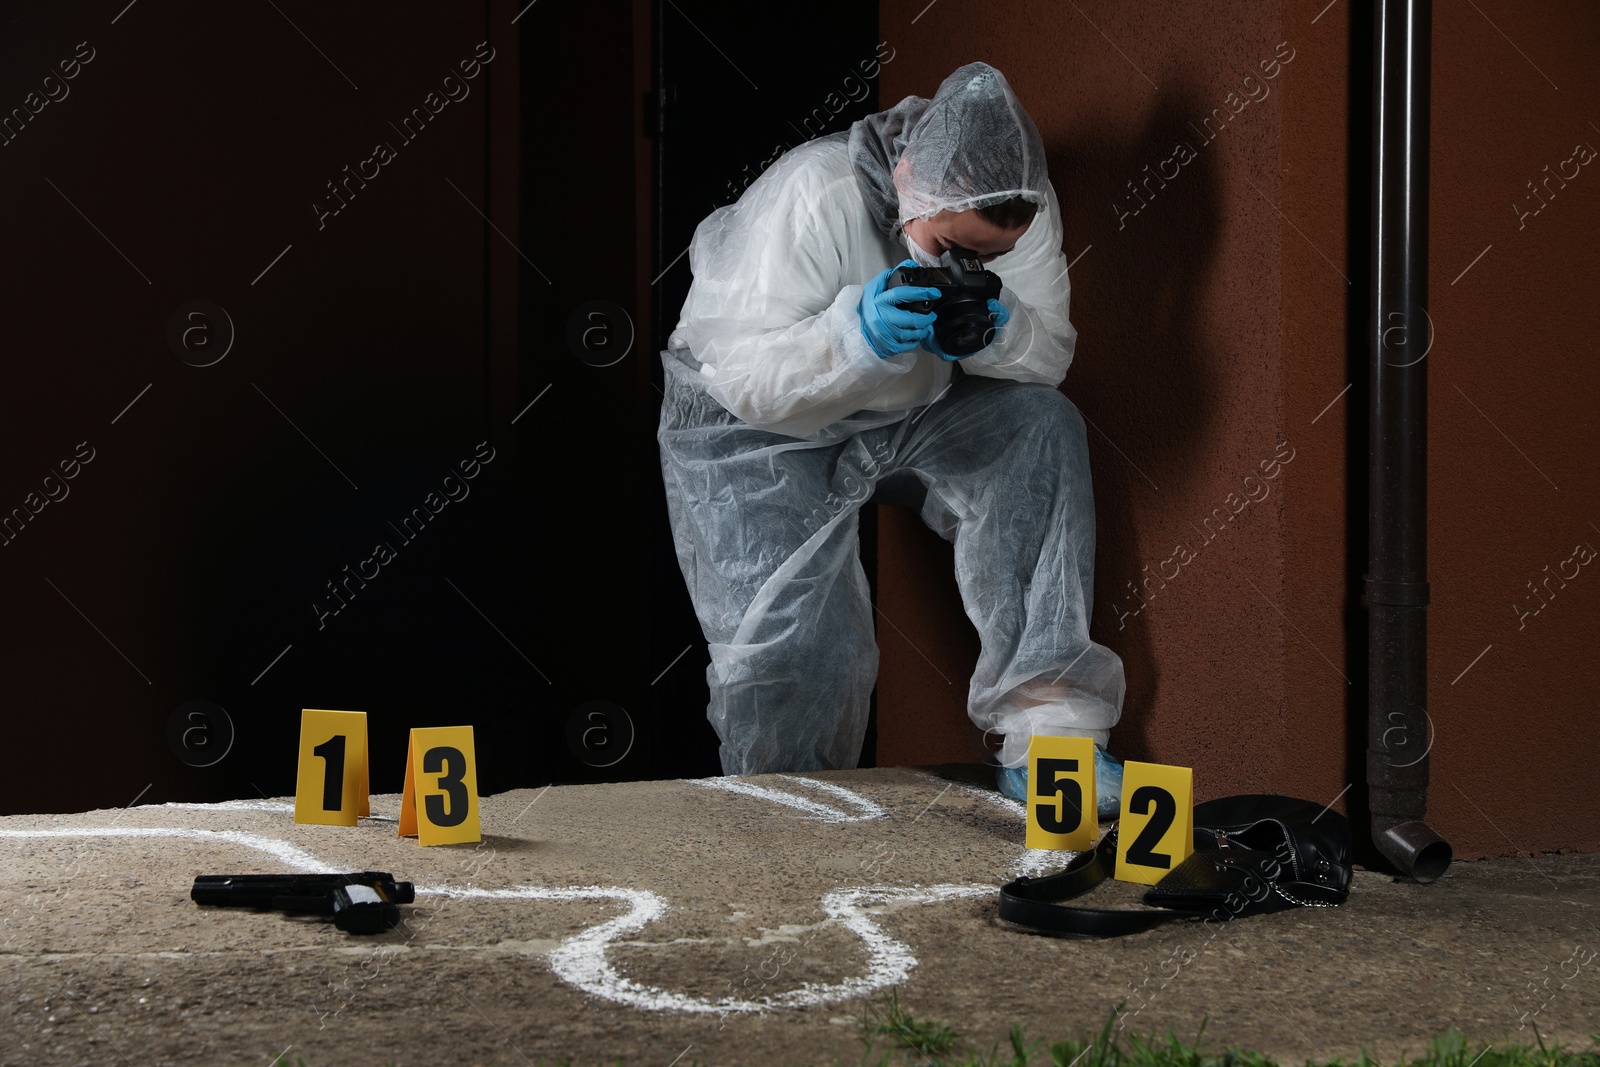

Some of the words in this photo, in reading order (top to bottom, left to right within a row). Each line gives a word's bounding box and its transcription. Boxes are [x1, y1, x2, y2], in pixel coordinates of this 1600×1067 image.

[314, 736, 346, 811] 1
[424, 746, 469, 827] 3
[1035, 758, 1082, 834] 5
[1125, 786, 1176, 869] 2
